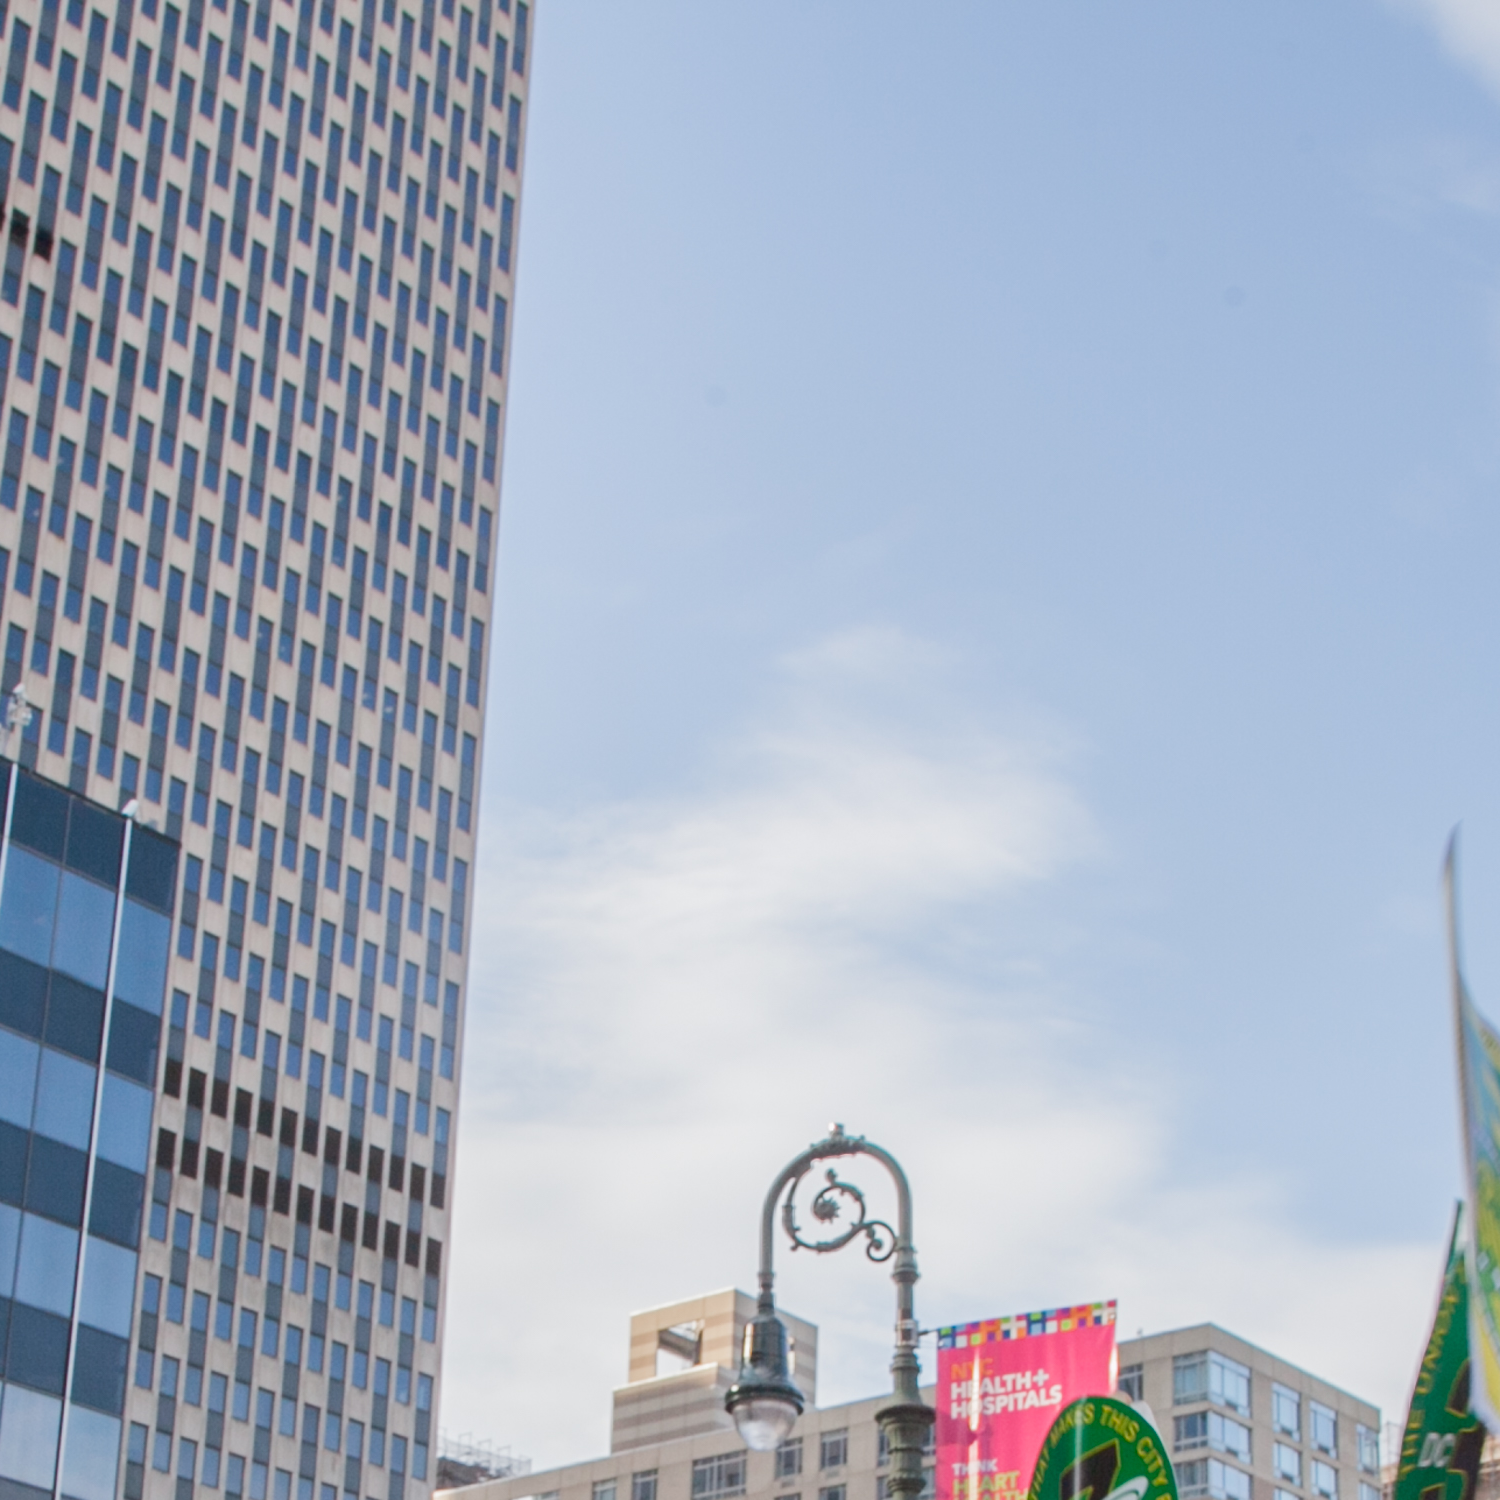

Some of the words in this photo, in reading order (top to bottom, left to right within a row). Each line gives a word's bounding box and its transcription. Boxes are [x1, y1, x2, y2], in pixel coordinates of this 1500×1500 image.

[951, 1358, 994, 1380] NYC
[951, 1368, 1050, 1400] HEALTH+
[951, 1384, 1063, 1420] HOSPITALS
[1050, 1402, 1096, 1449] MAKES
[1100, 1404, 1141, 1443] THIS
[1136, 1436, 1169, 1487] CITY
[1418, 1431, 1455, 1469] DC
[953, 1470, 1020, 1496] HEART
